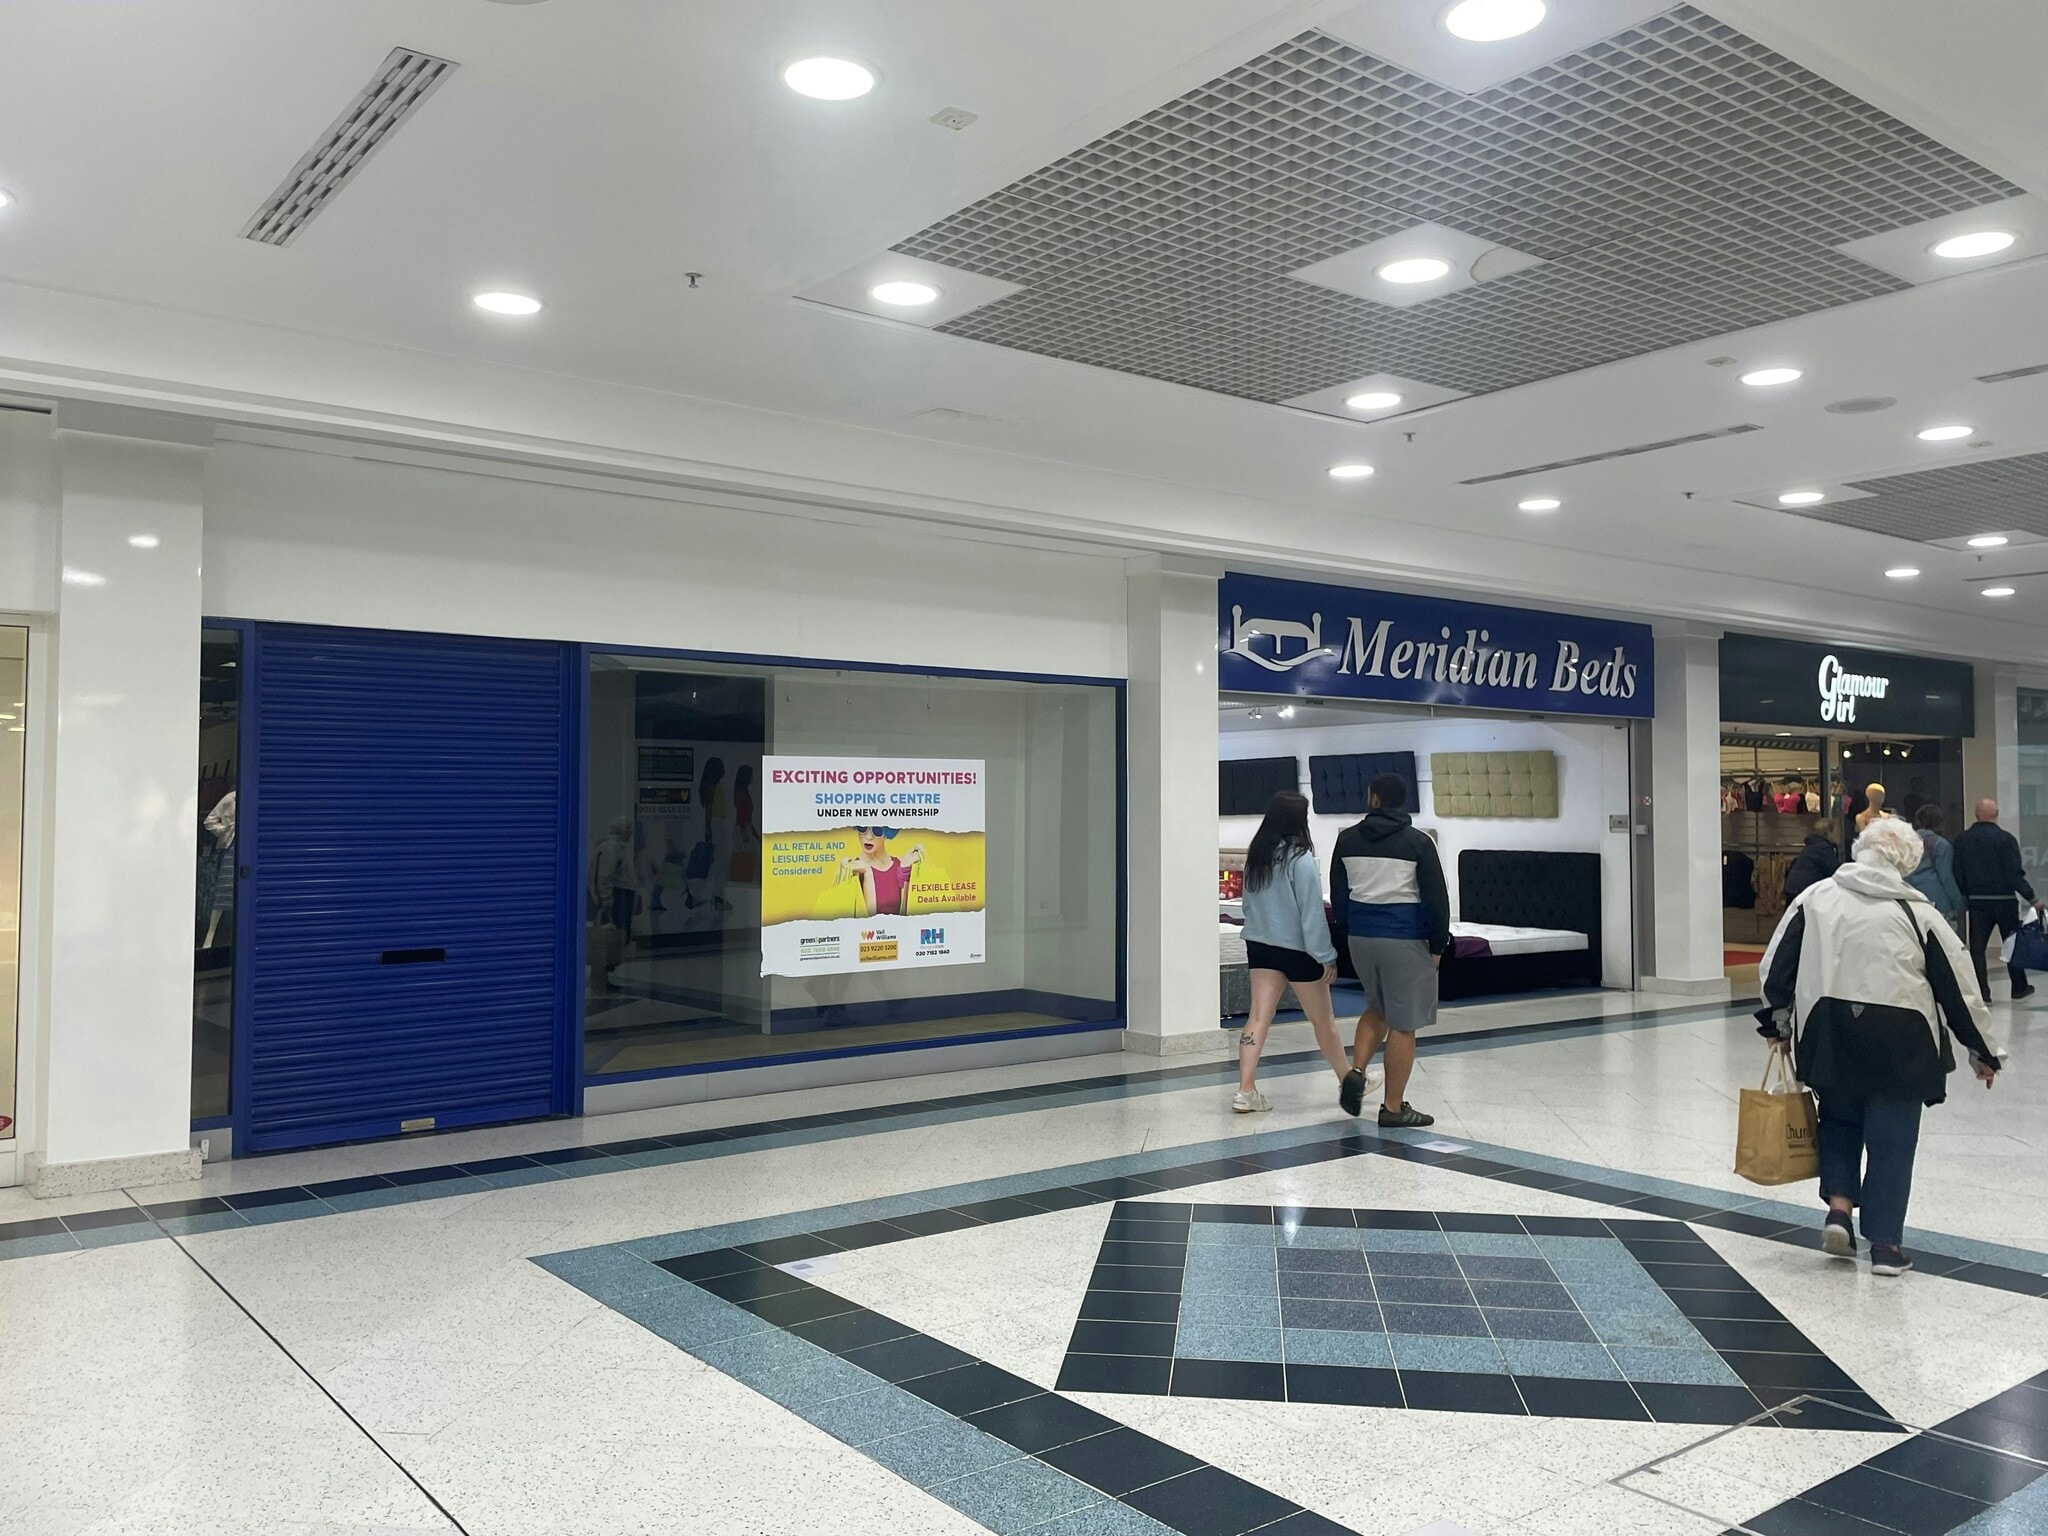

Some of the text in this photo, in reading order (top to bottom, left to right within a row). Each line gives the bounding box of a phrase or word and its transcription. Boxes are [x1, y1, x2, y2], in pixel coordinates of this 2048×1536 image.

[1336, 616, 1637, 699] Meridian Beds
[1818, 654, 1889, 700] Glamour
[772, 770, 977, 785] EXCITING OPPORTUNITIES!
[815, 793, 941, 805] SHOPPING CENTRE
[817, 808, 939, 817] UNDER NEW OWNERSHIP
[772, 841, 846, 851] ALL RETAIL AND
[772, 853, 836, 864] LEISURE USES
[772, 866, 823, 876] Considered
[911, 882, 977, 892] FLEXIBLE LEASE
[917, 893, 977, 903] Deals Available
[920, 928, 945, 945] RH
